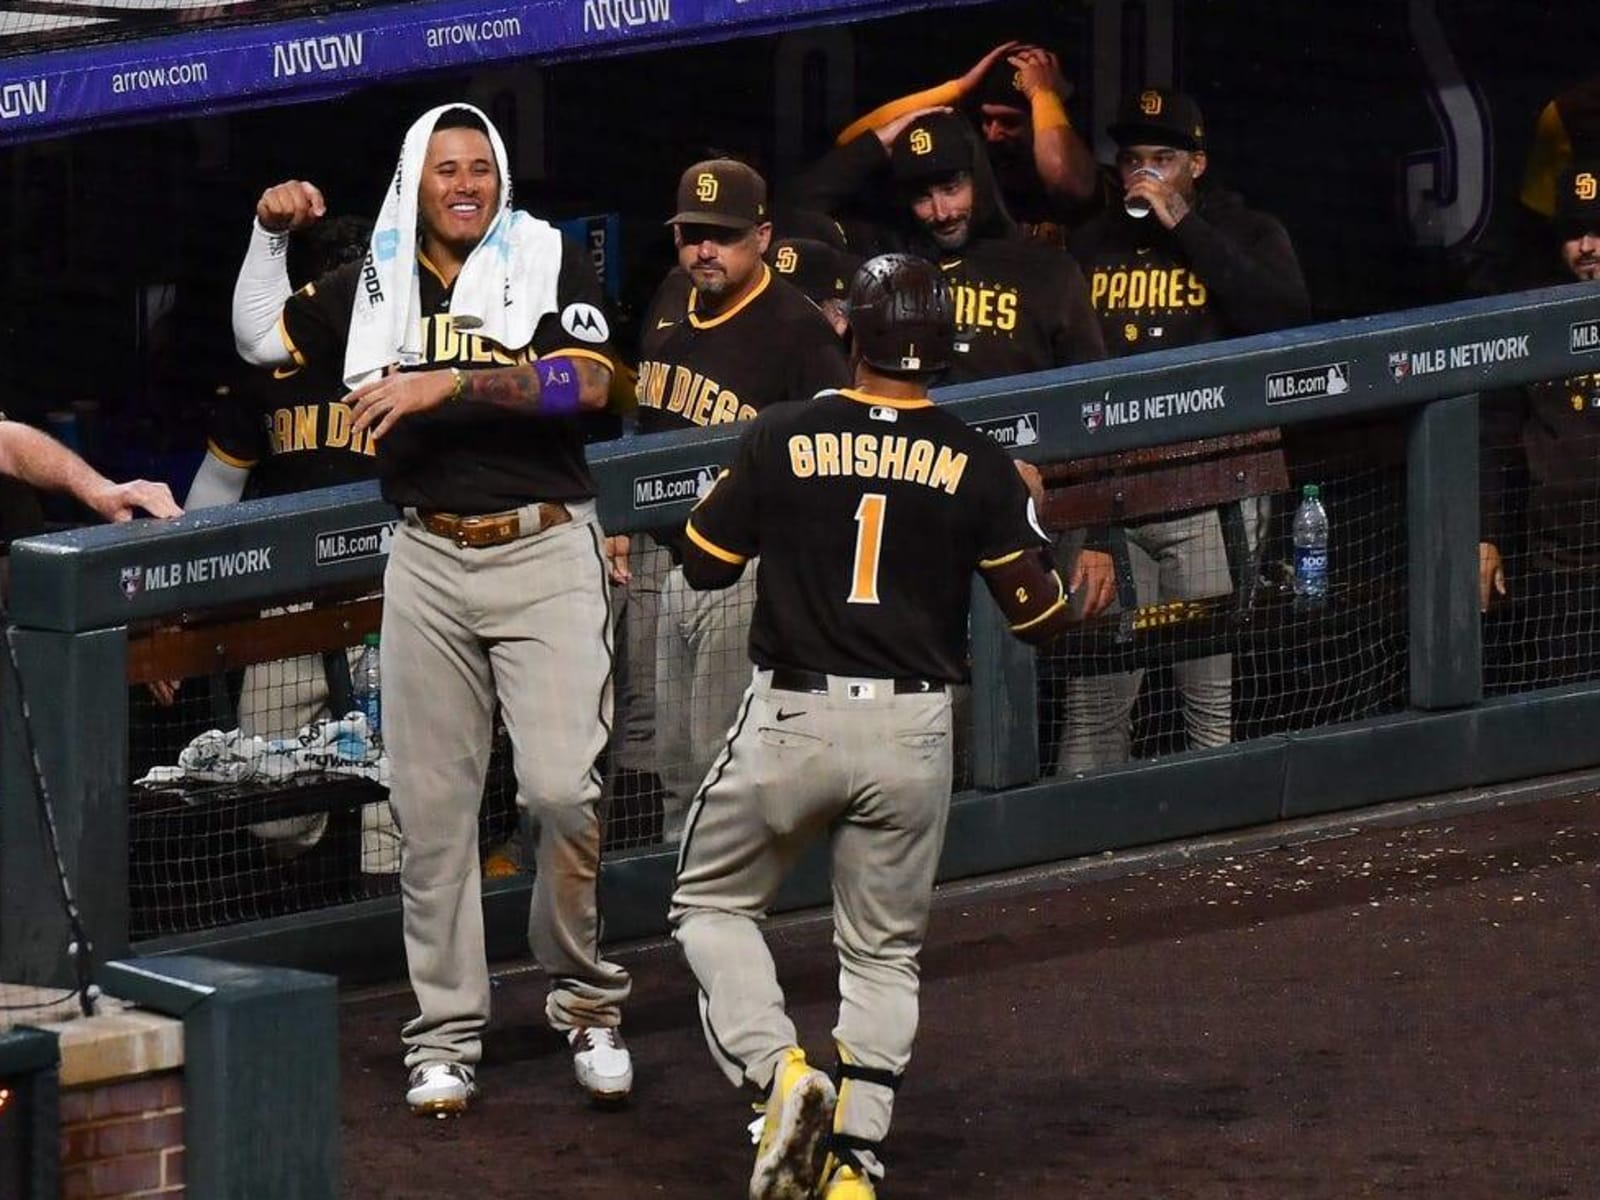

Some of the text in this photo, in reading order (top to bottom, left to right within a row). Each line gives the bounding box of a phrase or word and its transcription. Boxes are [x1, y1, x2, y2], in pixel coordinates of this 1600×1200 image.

[426, 17, 521, 47] arrow.com
[274, 32, 363, 78] ARROW
[112, 62, 208, 93] arrow.com
[1140, 91, 1162, 115] SD
[911, 128, 932, 155] SD
[697, 172, 719, 202] SD
[1575, 172, 1597, 200] SD
[776, 245, 799, 273] SD
[1091, 268, 1206, 310] PADRES
[1411, 349, 1446, 376] MLB
[1449, 335, 1530, 369] NETWORK
[1268, 375, 1326, 400] MLB.com
[1105, 400, 1140, 427] MLB
[1144, 386, 1226, 420] NETWORK
[787, 432, 969, 496] GRISHAM
[635, 479, 696, 503] MLB.com
[318, 534, 379, 560] MLB.com
[846, 493, 887, 605] 1
[145, 563, 182, 592] MLB
[186, 547, 272, 583] NETWORK
